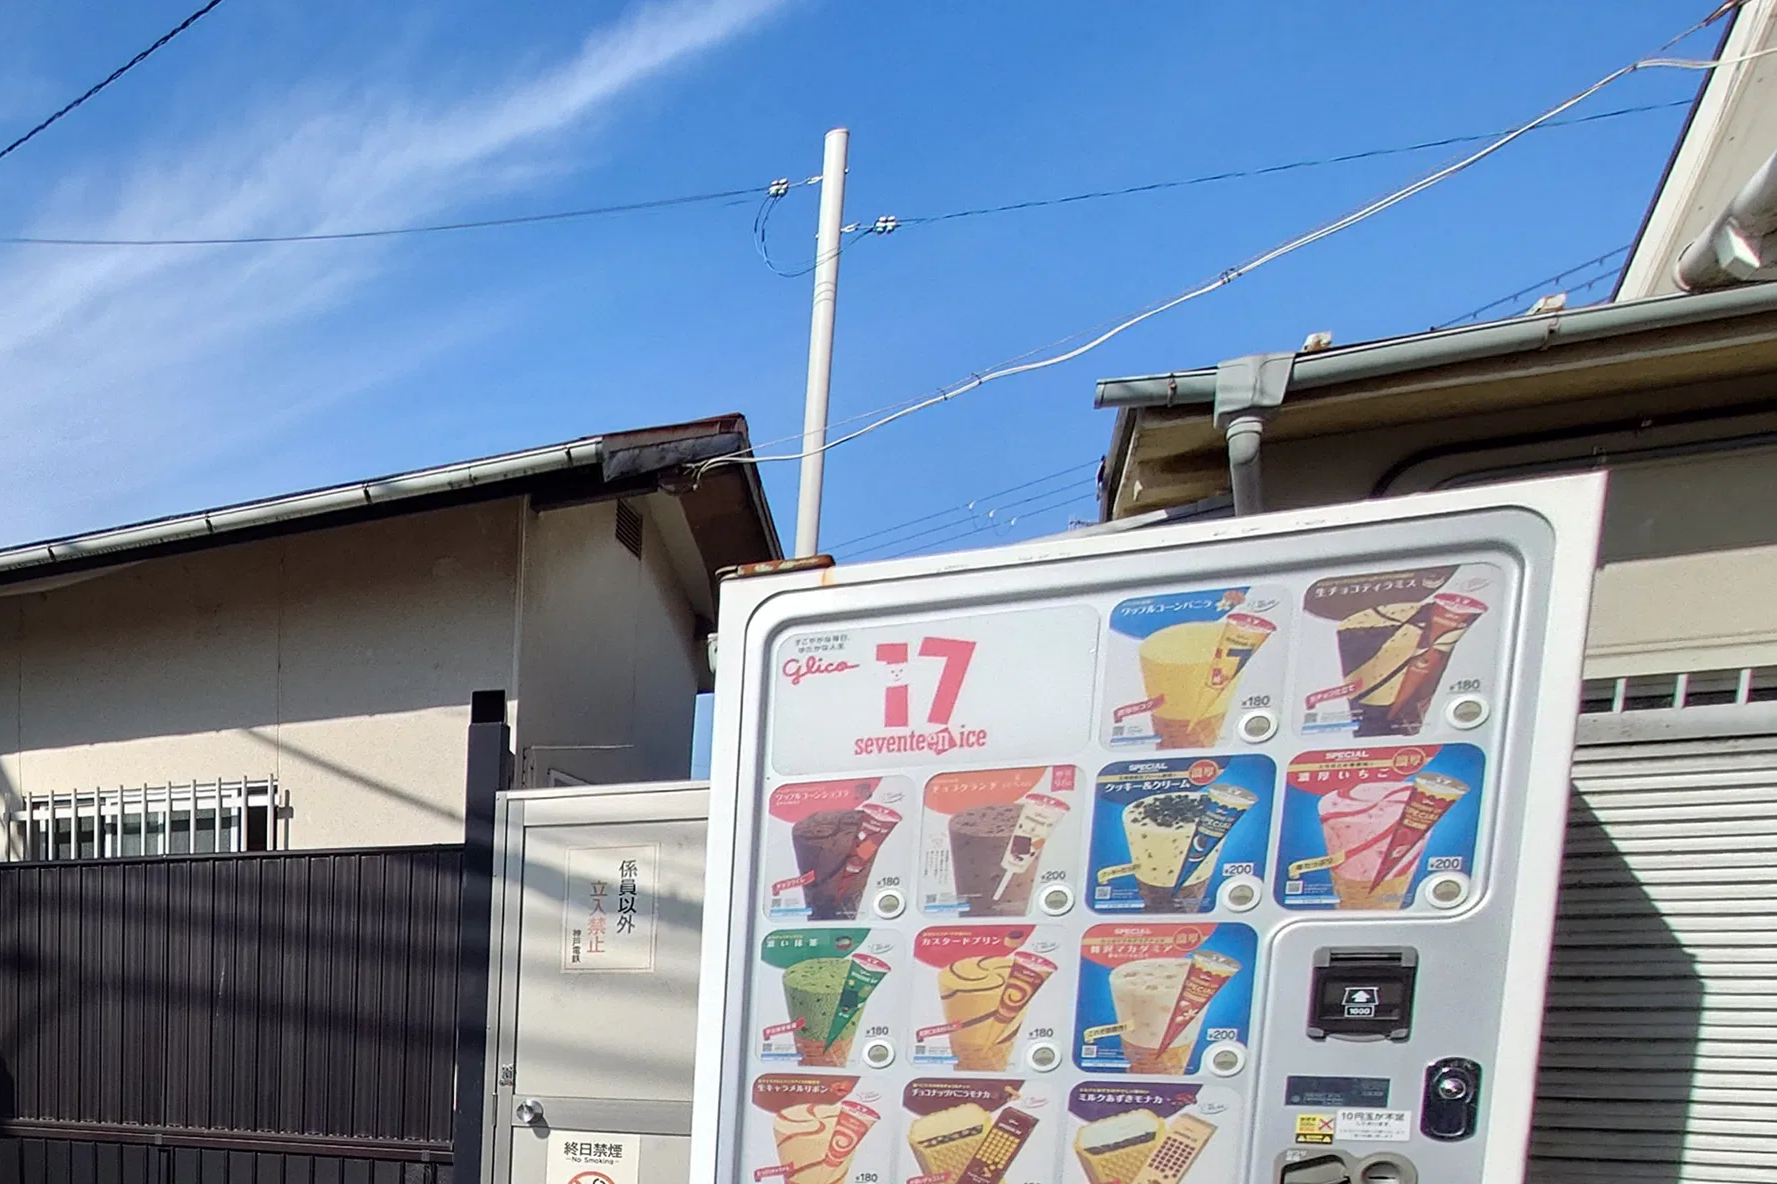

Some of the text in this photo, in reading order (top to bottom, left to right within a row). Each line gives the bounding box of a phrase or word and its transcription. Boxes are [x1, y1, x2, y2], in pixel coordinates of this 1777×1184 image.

[782, 656, 860, 685] Glico
[854, 725, 988, 756] seventeen ice
[1325, 750, 1370, 760] SPECIAL
[1297, 767, 1390, 782] 濃厚いちご
[1105, 779, 1191, 793] クッキー&クリーム
[1224, 863, 1252, 875] ¥200
[1429, 858, 1460, 870] ¥200
[617, 859, 638, 935] 係員以外
[587, 880, 608, 954] 立入禁止
[571, 928, 582, 964] 神戸電鉄
[922, 936, 1001, 946] カスタードプリン
[1349, 1007, 1371, 1015] 1000
[1208, 1029, 1236, 1040] ¥200
[564, 1141, 624, 1159] 終日禁煙
